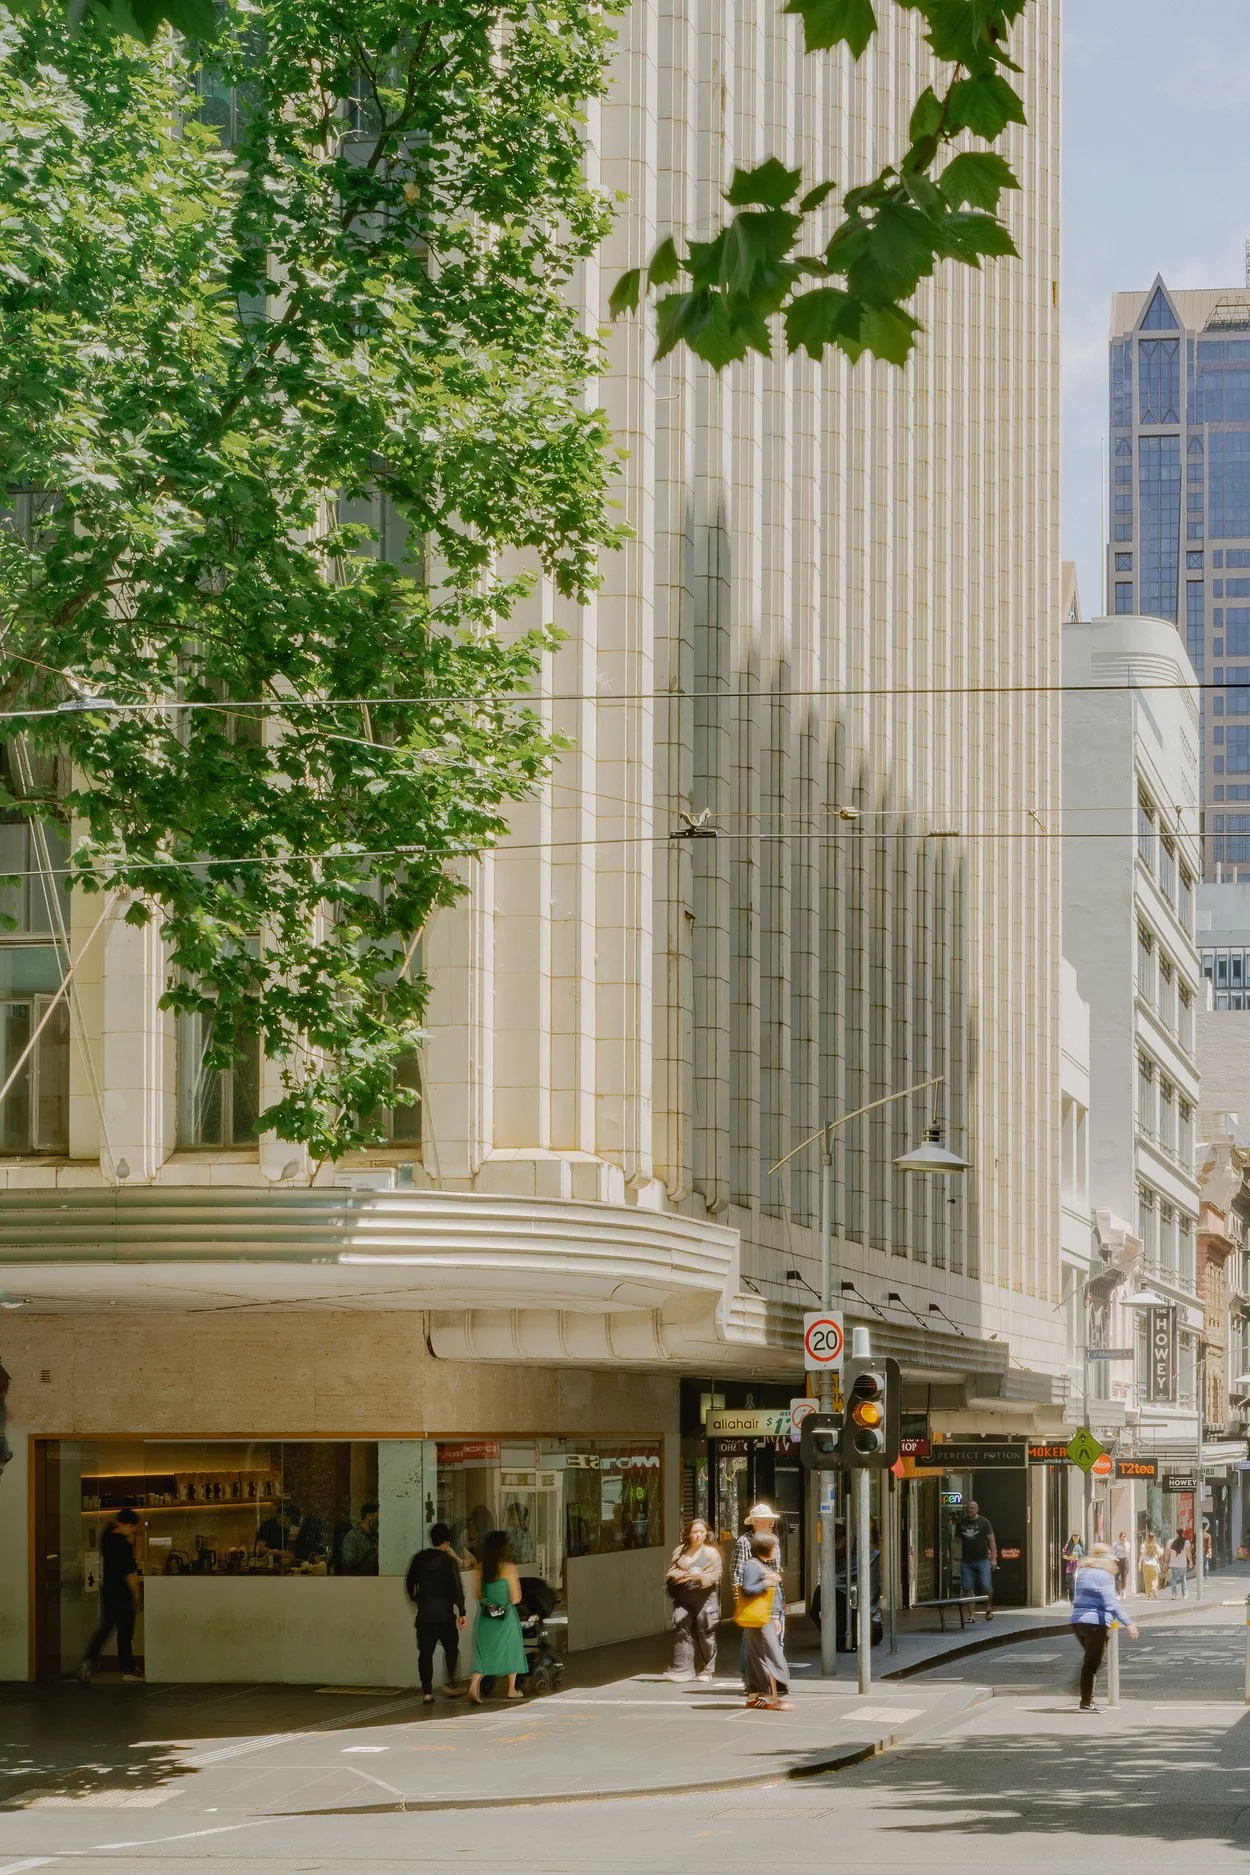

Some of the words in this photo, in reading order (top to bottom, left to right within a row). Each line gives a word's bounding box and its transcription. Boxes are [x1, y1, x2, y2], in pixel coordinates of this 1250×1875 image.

[813, 1330, 838, 1351] 20
[1154, 1318, 1169, 1389] HOWEY
[713, 1418, 759, 1430] aliahair
[938, 1451, 979, 1460] PERFECT
[983, 1450, 1021, 1460] POTION
[1118, 1462, 1155, 1475] T2tea
